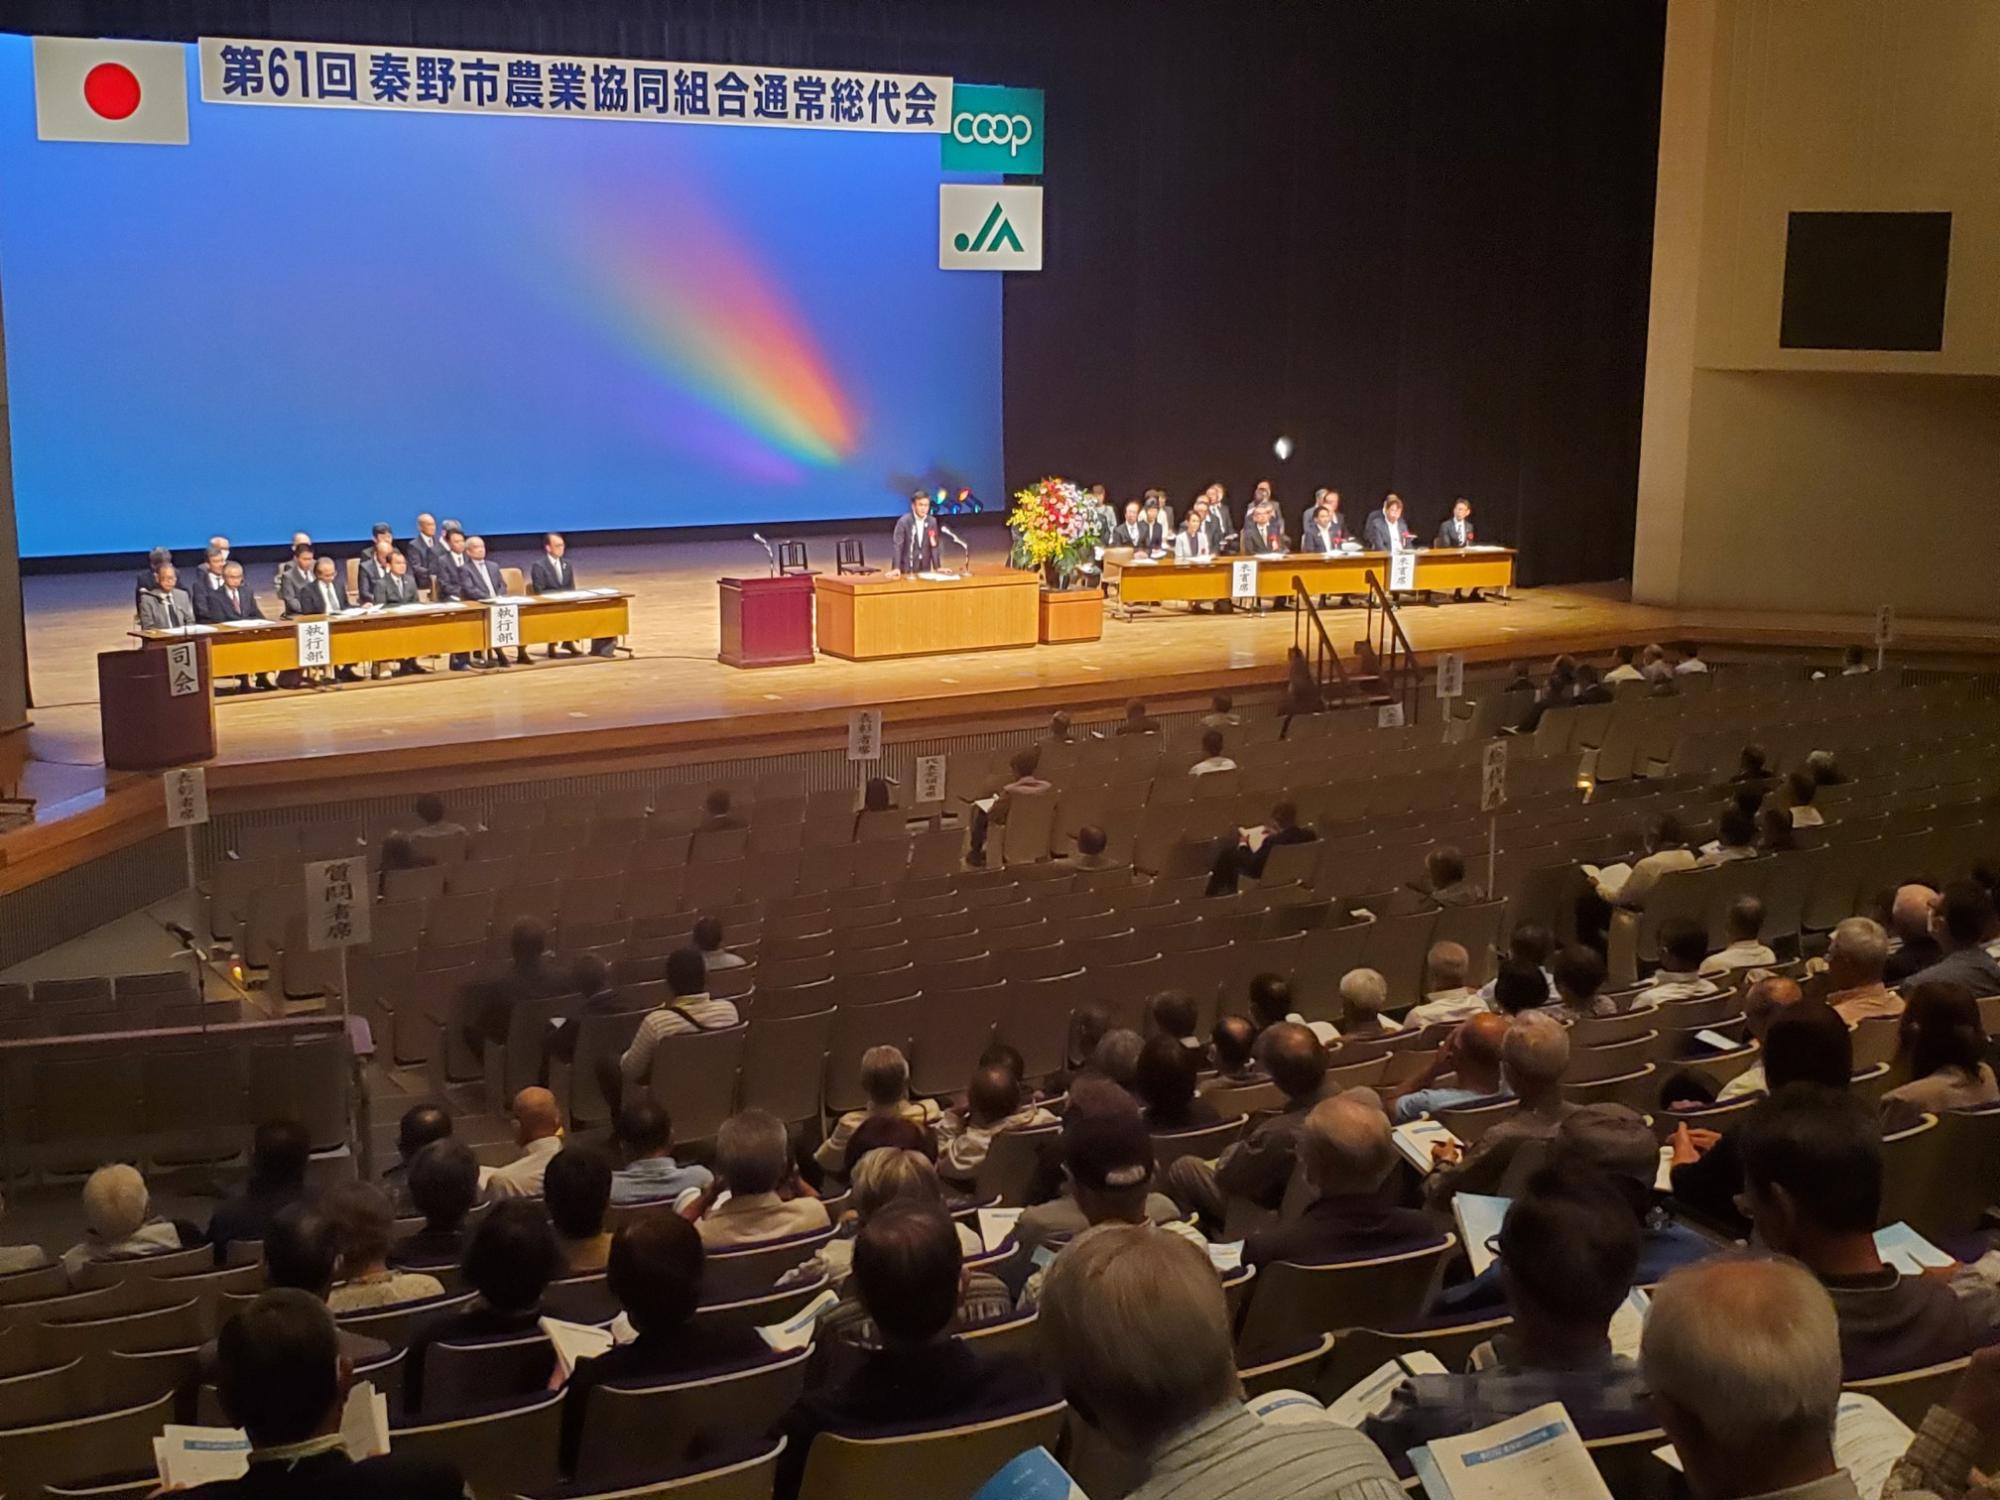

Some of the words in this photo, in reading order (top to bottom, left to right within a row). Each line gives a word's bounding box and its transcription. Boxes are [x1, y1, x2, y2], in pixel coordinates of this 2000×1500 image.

[220, 44, 358, 100] 第61回
[369, 52, 937, 125] 秦野市農業協同組合通常総代会
[304, 624, 324, 663] 執行部
[496, 607, 514, 644] 執行部
[171, 646, 196, 693] 司会
[324, 863, 356, 940] 質問者席
